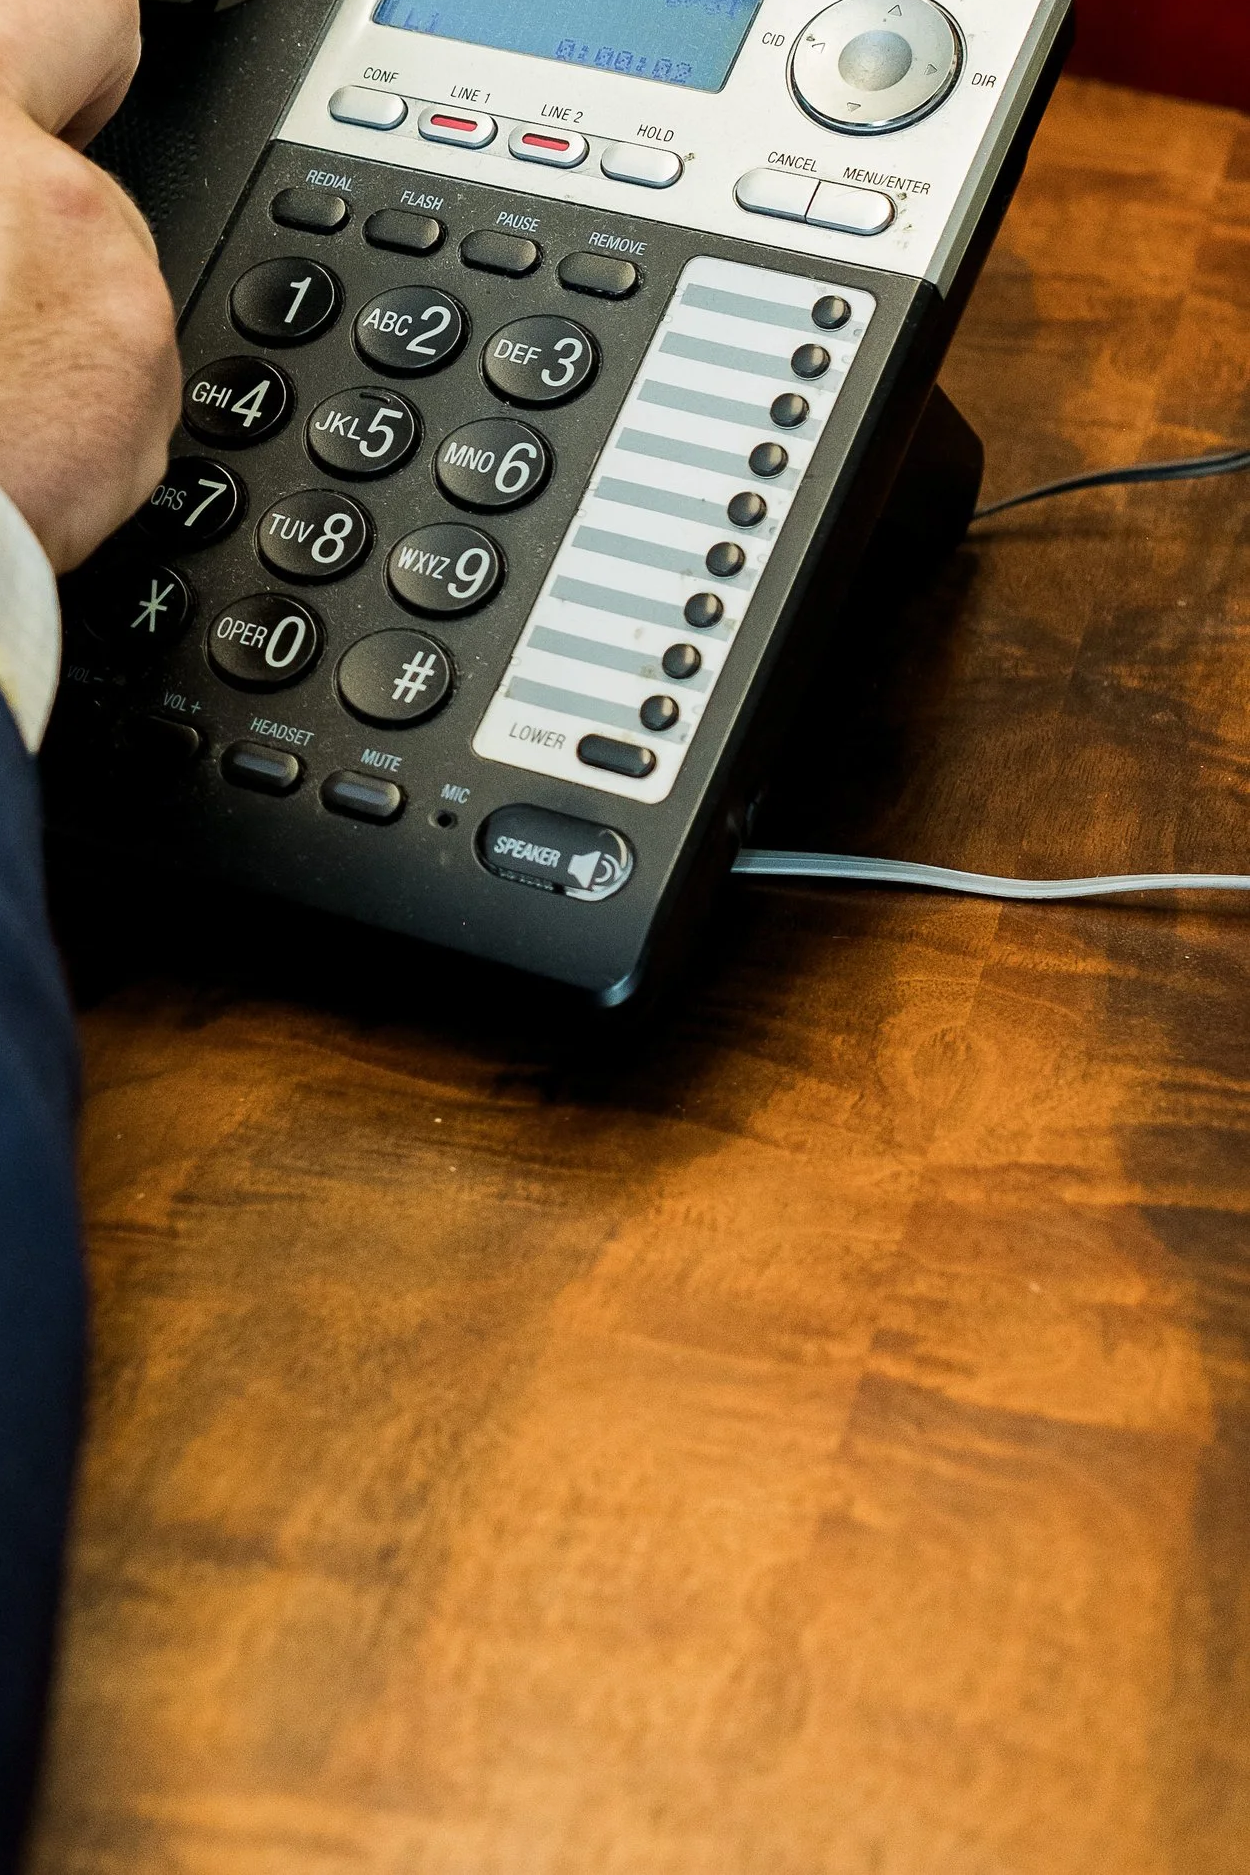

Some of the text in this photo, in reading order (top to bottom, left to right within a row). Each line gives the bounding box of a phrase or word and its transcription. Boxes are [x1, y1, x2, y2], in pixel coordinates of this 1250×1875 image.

[762, 32, 785, 47] CID
[363, 67, 399, 84] CONF
[971, 72, 997, 88] DIR
[450, 85, 491, 104] LINE 1
[541, 104, 584, 124] LINE 2
[637, 124, 675, 143] HOLD
[768, 151, 818, 173] CANCEL
[306, 169, 353, 193] REDIAL
[843, 167, 931, 195] MENU/ENTER
[400, 190, 444, 212] FLASH
[496, 211, 540, 233] PAUSE
[588, 232, 647, 256] REMOVE
[284, 277, 310, 324] 1
[363, 306, 453, 355] ABC 2
[493, 338, 584, 388] DEF 3
[191, 380, 272, 428] GHI 4
[315, 407, 407, 458] JKL 5
[443, 442, 539, 494] MNO 6
[150, 478, 228, 527] QRS 7
[268, 512, 355, 565] TUV 8
[398, 547, 492, 600] WXYZ 9
[216, 615, 307, 668] OPER 0
[392, 650, 436, 704] #
[163, 692, 188, 713] VOL
[250, 717, 315, 747] HEADSET
[508, 722, 567, 750] LOWER
[360, 748, 403, 773] MUTE
[441, 783, 471, 804] MIC
[493, 835, 561, 868] SPEAKER
